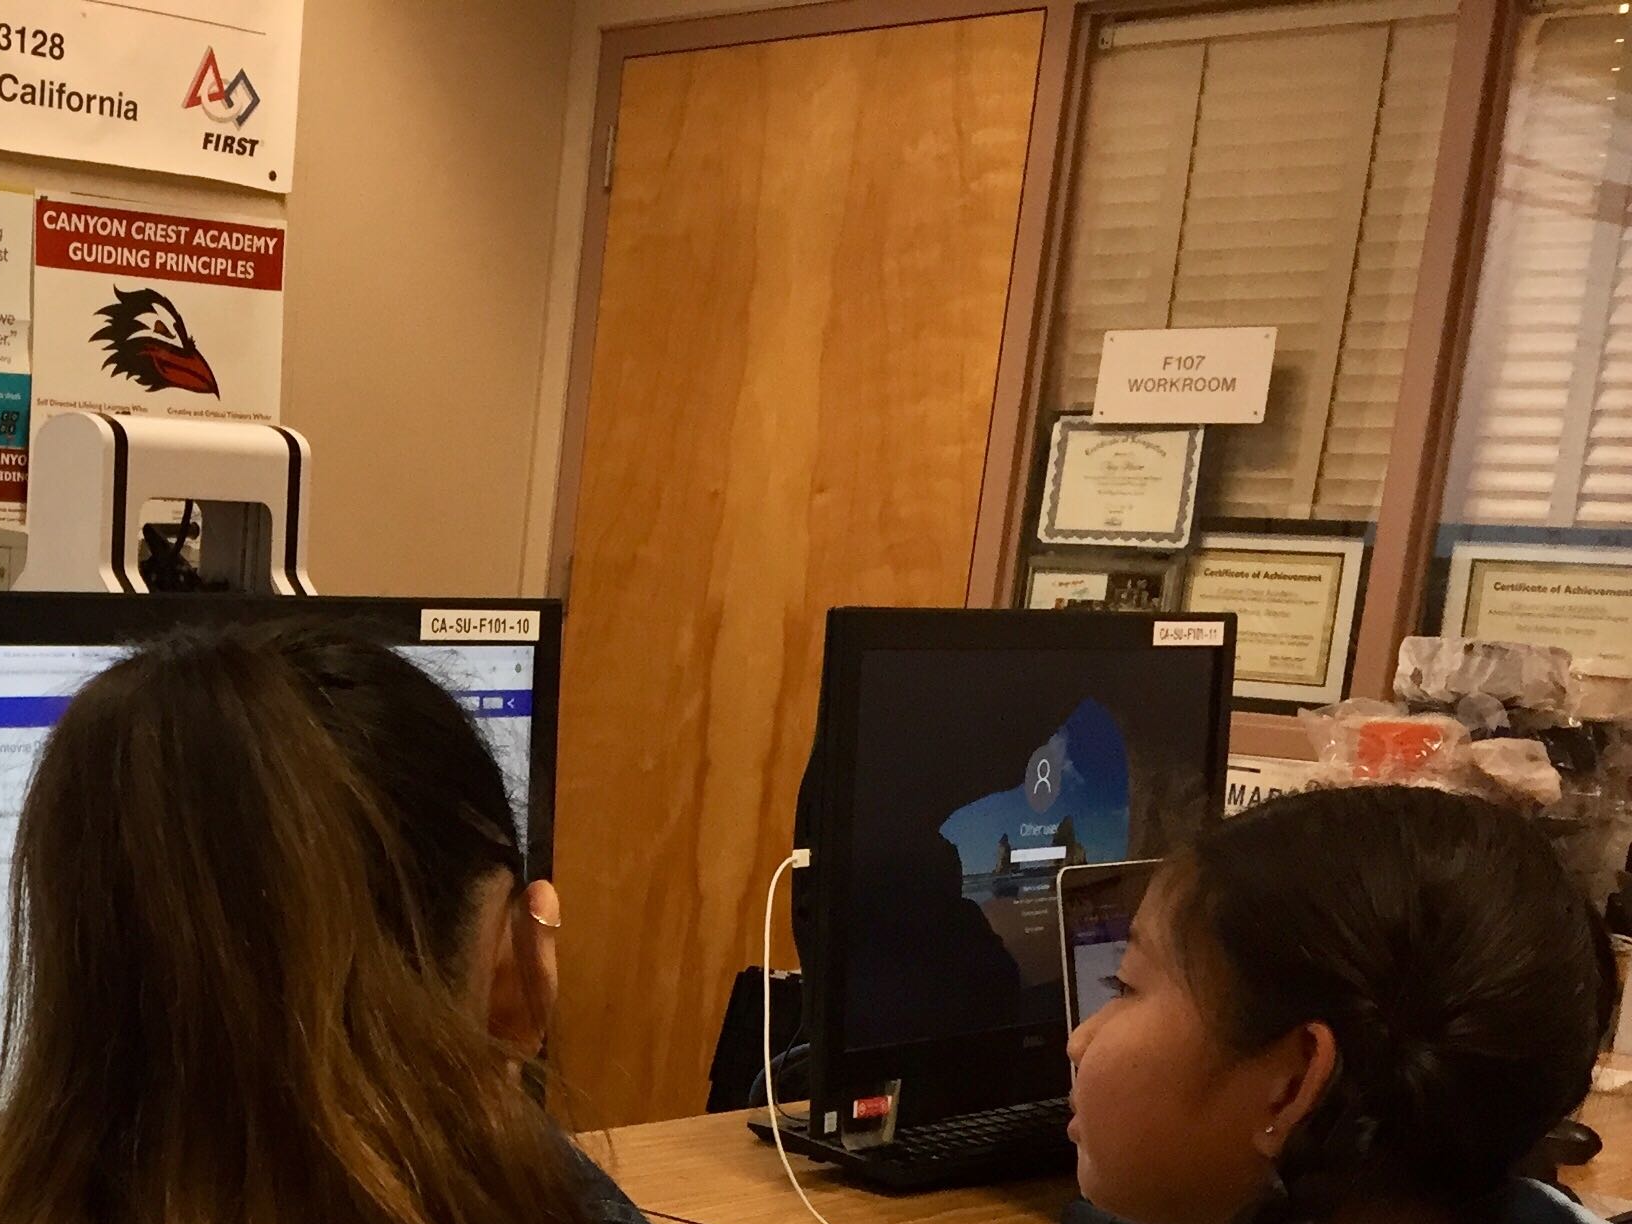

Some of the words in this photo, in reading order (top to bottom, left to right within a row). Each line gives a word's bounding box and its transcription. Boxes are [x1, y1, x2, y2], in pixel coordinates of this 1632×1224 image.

[202, 132, 259, 157] FIRST
[43, 210, 127, 237] CANYON
[131, 221, 190, 245] CREST
[192, 229, 278, 255] ACADEMY
[68, 241, 150, 268] GUIDING
[155, 251, 255, 280] PRINCIPLES
[1162, 355, 1206, 371] F107
[1127, 377, 1237, 392] WORKROOM
[1204, 568, 1249, 578] Certificate
[1251, 570, 1261, 579] of
[1263, 571, 1322, 582] Achievement
[1493, 582, 1547, 593] Certificate
[1550, 585, 1561, 594] of
[431, 617, 529, 634] CA-SU-F101-10
